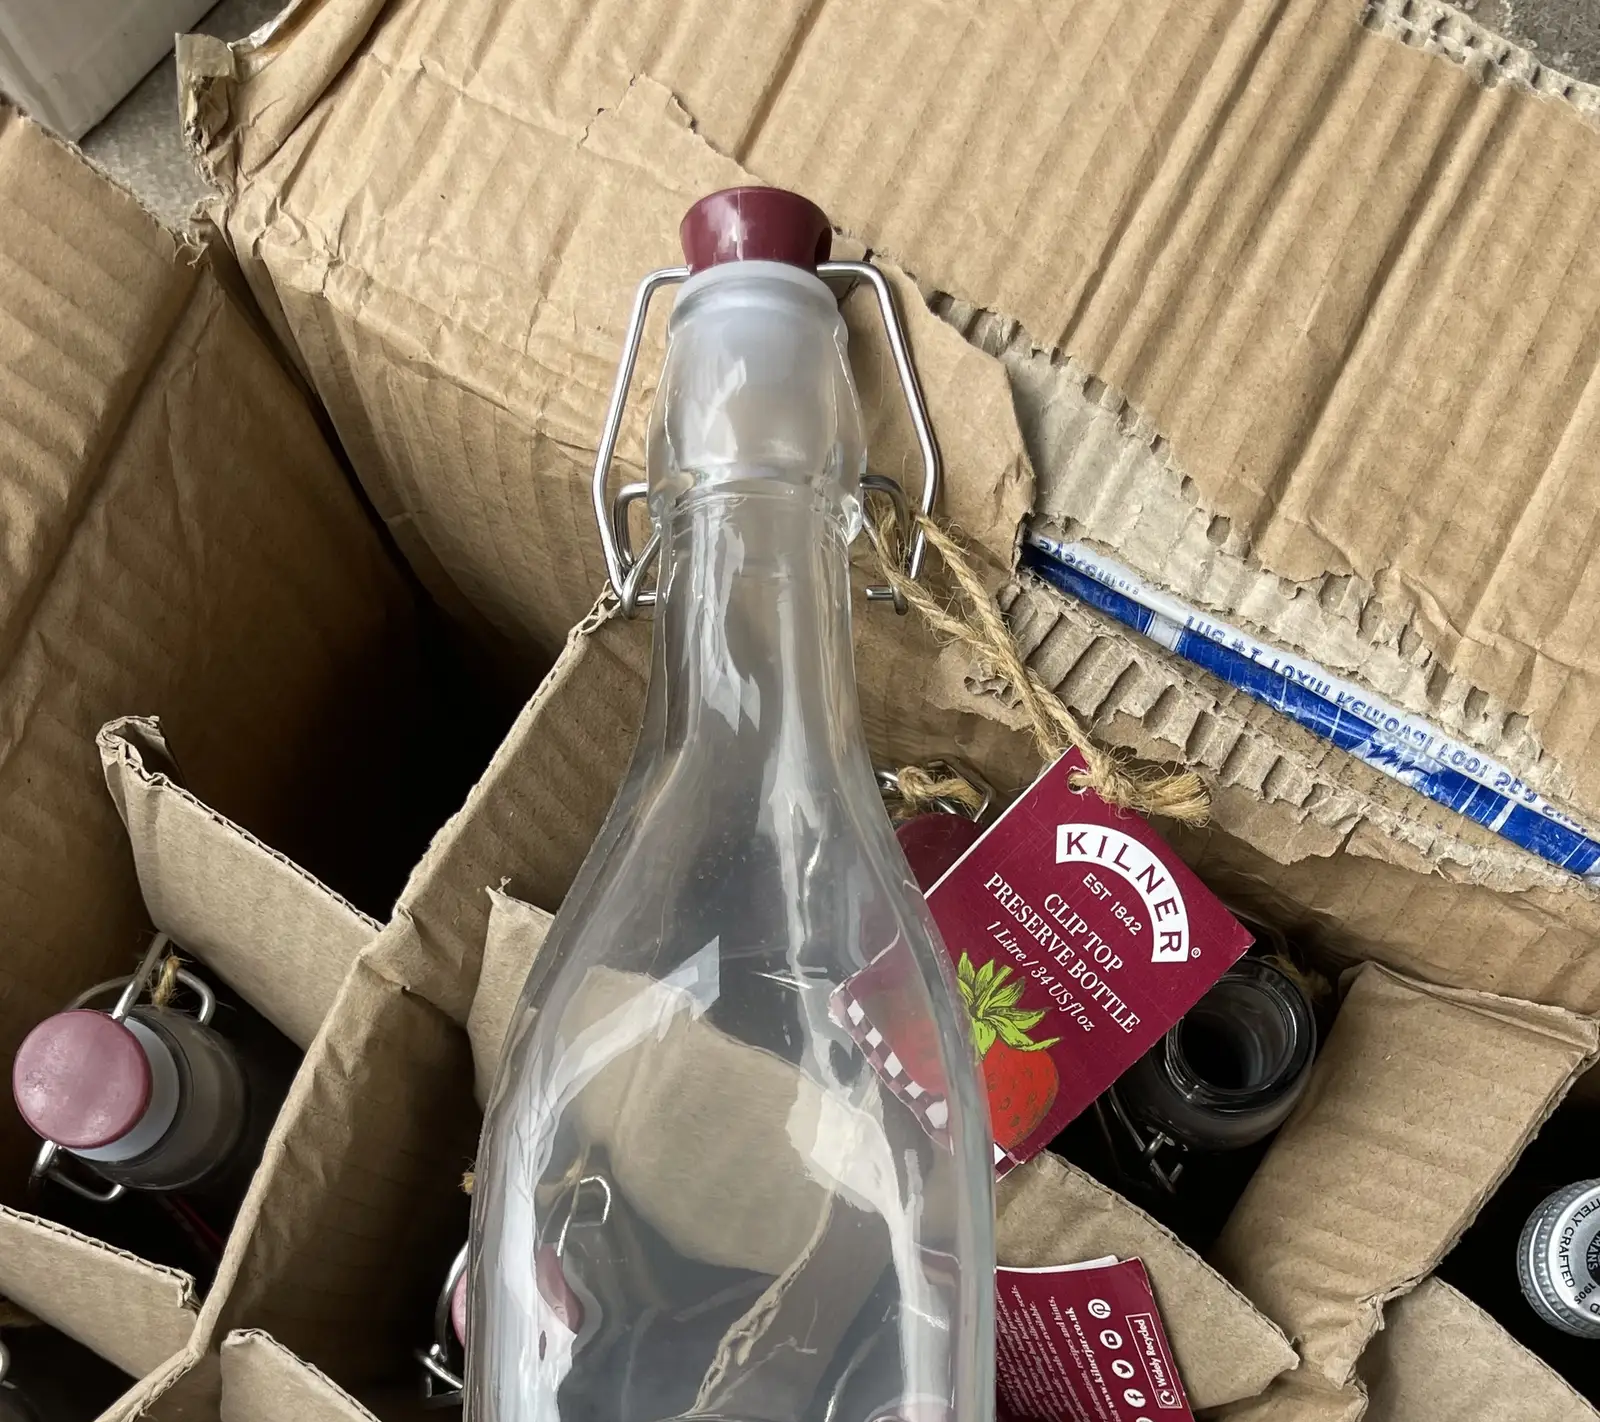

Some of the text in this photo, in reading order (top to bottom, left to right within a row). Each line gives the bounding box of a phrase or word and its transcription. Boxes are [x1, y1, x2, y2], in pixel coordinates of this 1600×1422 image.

[1065, 831, 1184, 955] KILNER
[1082, 872, 1142, 935] EST 1842
[984, 873, 1140, 1032] PRESERVE BOTTLE
[1043, 893, 1123, 972] CLIP TOP
[993, 928, 1026, 961] Litre
[1030, 966, 1054, 985] 34
[1076, 1014, 1095, 1031] oz
[1558, 1226, 1576, 1288] CRAFTED
[1048, 1295, 1062, 1321] hints,
[1573, 1282, 1597, 1305] 1905
[1055, 1321, 1070, 1338] and
[1065, 1338, 1084, 1369] recipes
[1065, 1307, 1113, 1408] www.kilnerjar.co.uk
[1133, 1318, 1168, 1388] Widely Recycled
